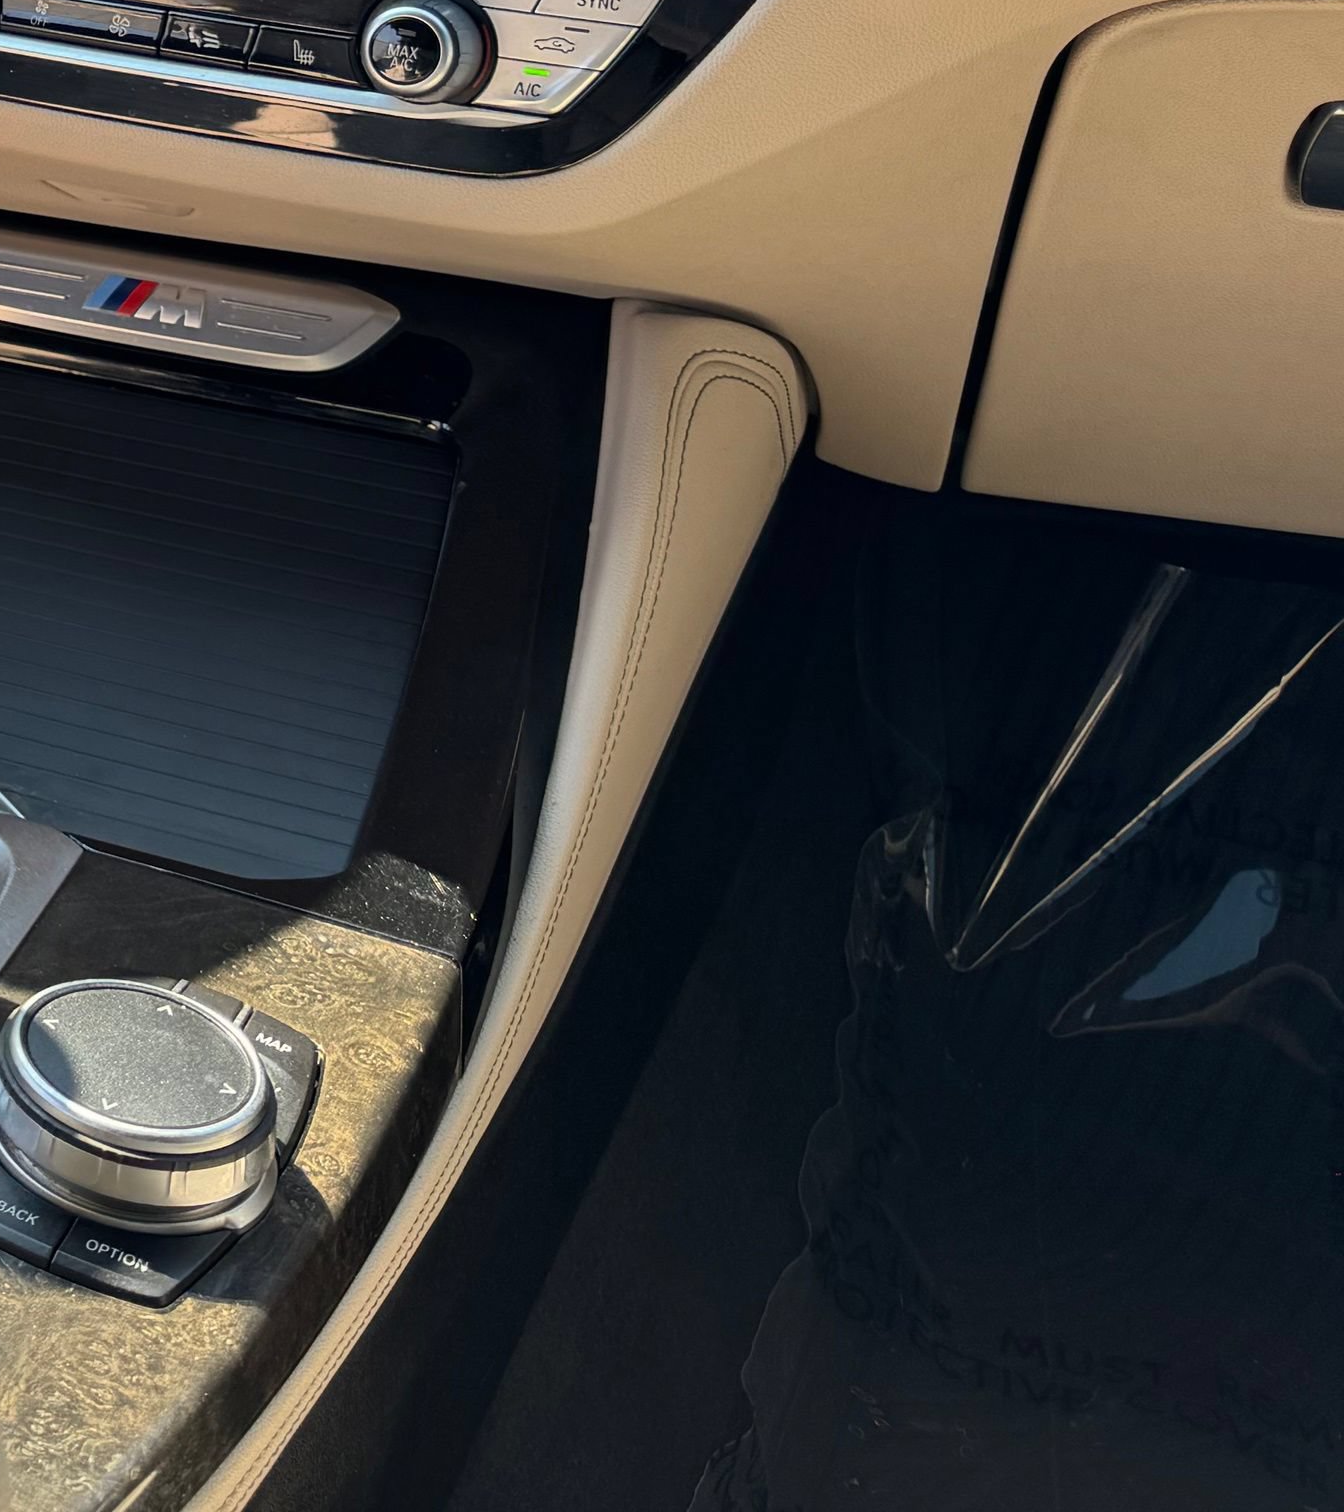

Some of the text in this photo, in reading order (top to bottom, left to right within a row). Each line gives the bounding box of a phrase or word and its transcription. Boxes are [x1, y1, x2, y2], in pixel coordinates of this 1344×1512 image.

[30, 15, 48, 28] OFF
[387, 43, 419, 60] MAX
[390, 56, 414, 73] A/C
[513, 81, 542, 99] A/C
[255, 1032, 293, 1054] MAP
[85, 1238, 150, 1273] OPTION
